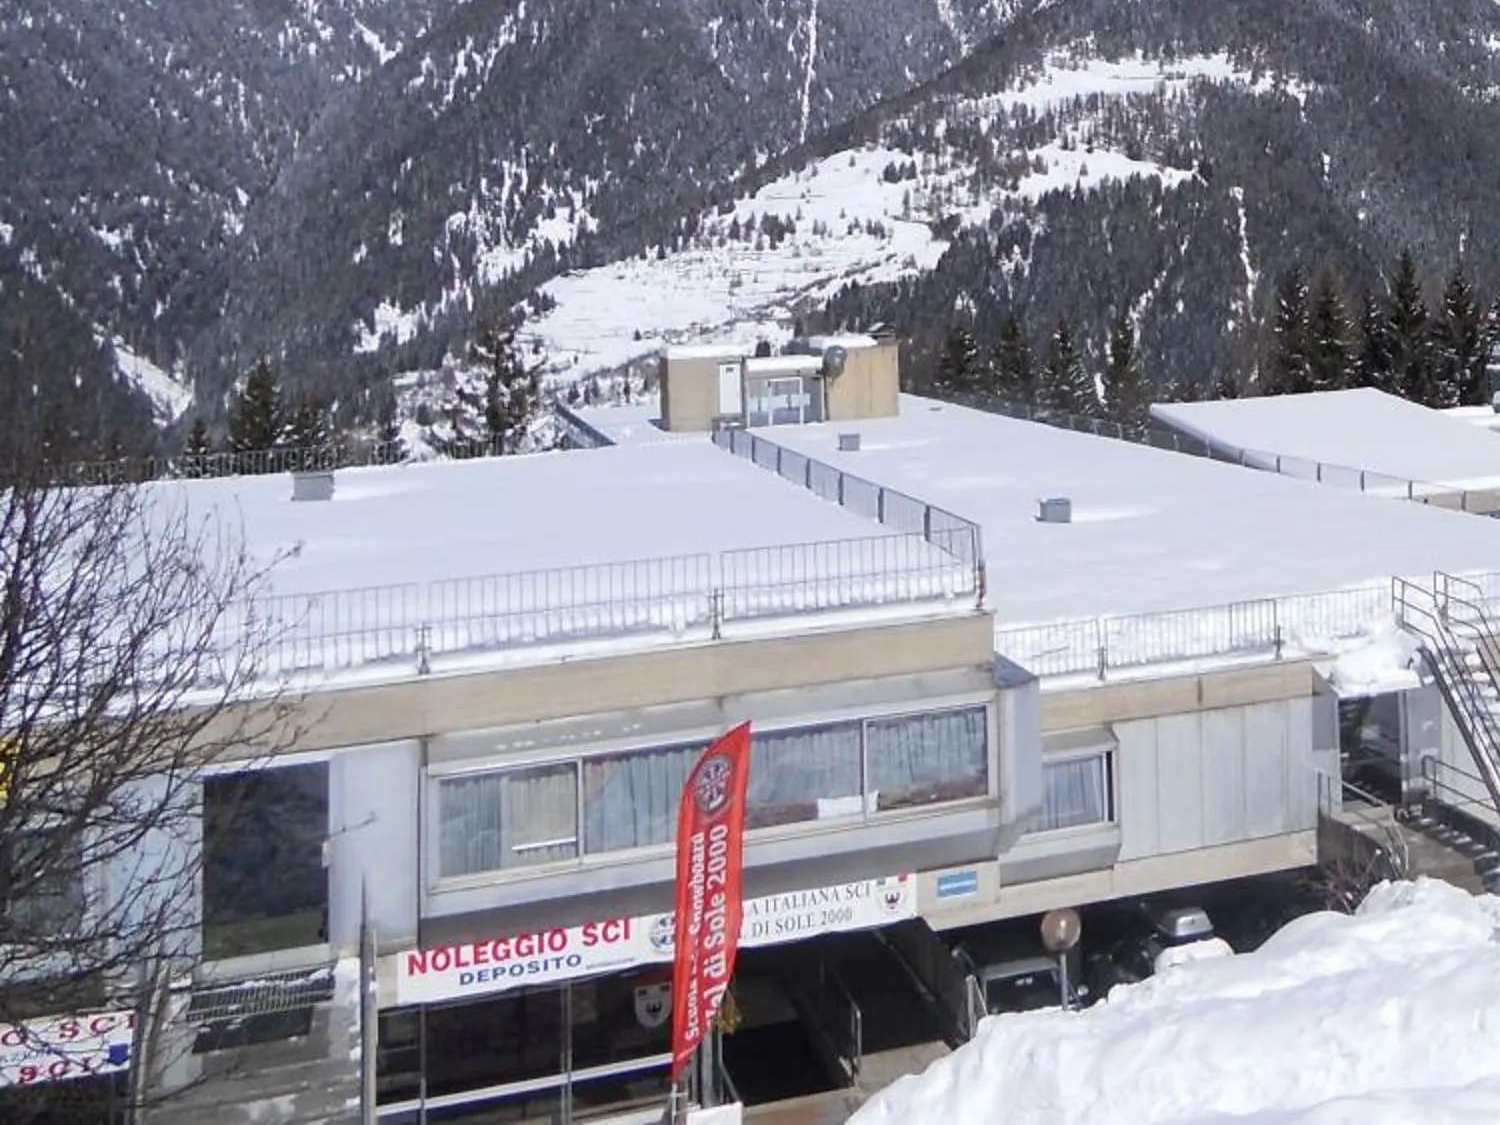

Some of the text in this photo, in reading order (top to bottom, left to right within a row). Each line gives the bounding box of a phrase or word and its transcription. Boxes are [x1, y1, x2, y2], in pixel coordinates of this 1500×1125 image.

[706, 824, 728, 889] 2000
[765, 886, 841, 913] ITALIANA
[847, 882, 871, 901] SCI
[704, 892, 726, 950] Sole
[752, 907, 853, 938] DI SOLE 2000
[407, 917, 631, 976] NOLEGGIO SCI
[459, 954, 582, 986] DEPOSITO
[704, 950, 726, 978] di
[59, 1013, 138, 1039] SCI
